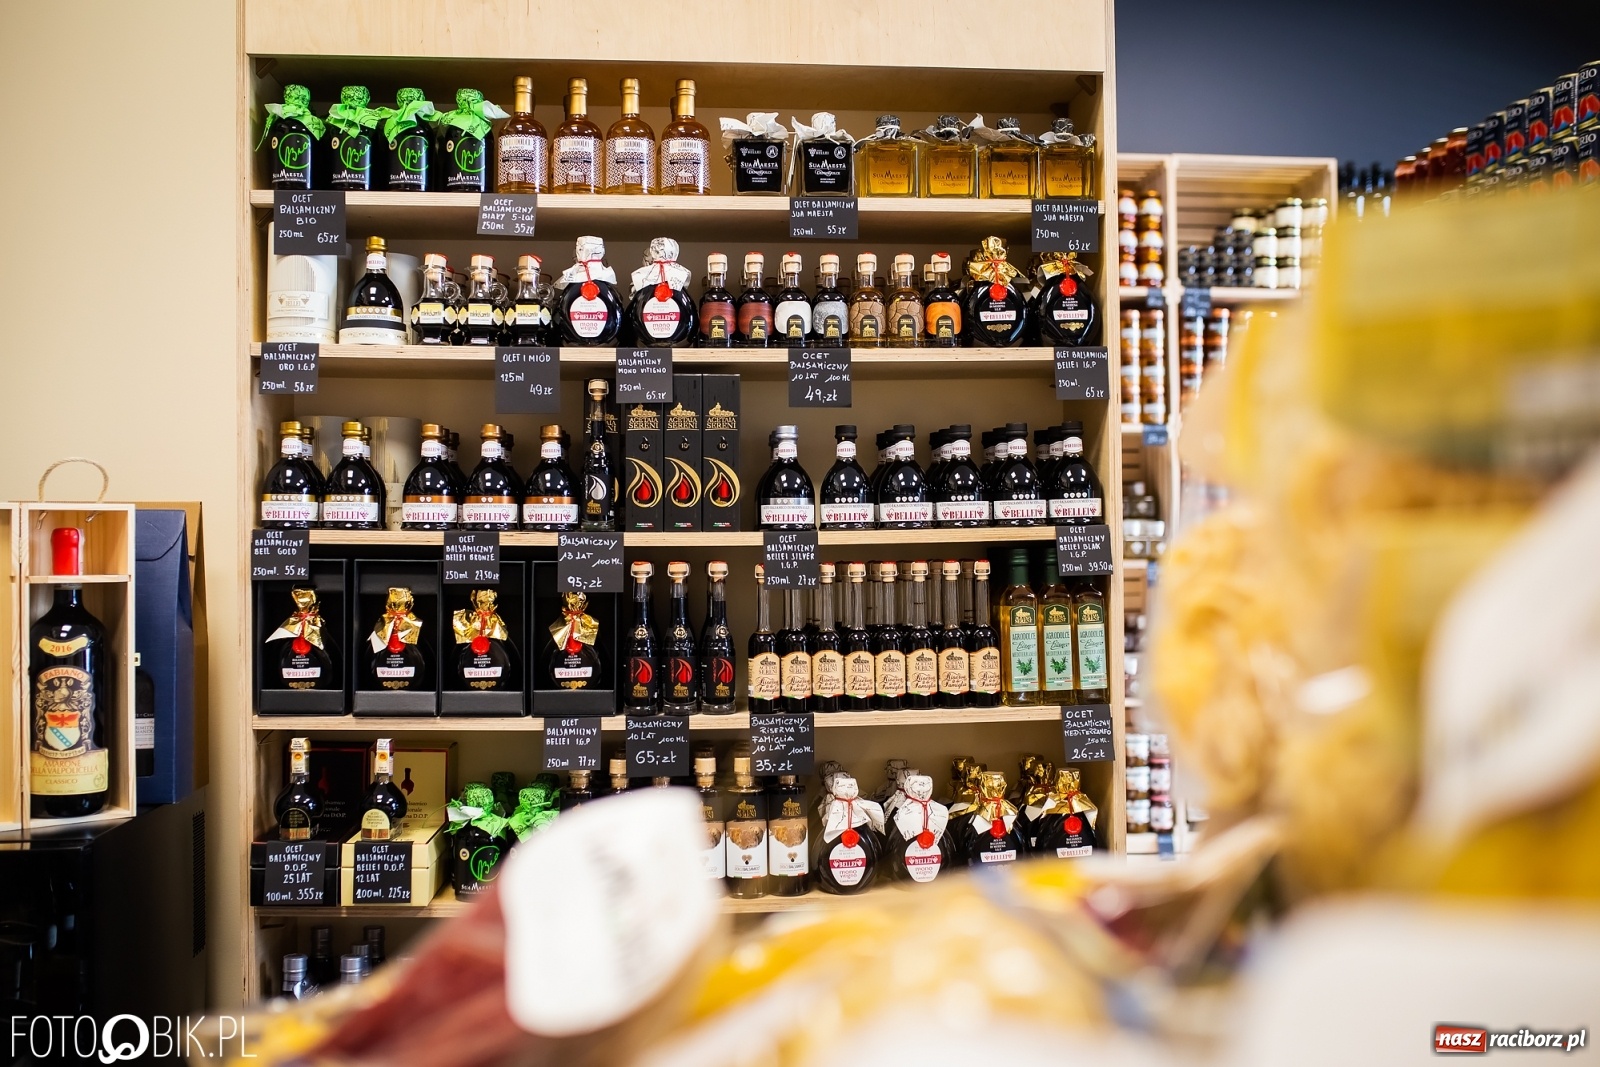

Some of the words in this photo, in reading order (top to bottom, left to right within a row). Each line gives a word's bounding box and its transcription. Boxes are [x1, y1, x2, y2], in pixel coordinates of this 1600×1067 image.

[292, 194, 313, 203] OCET
[280, 205, 336, 214] BALSAMICZNY
[1052, 205, 1097, 214] BALSAMICZNY
[297, 217, 316, 225] BIO
[1060, 214, 1083, 222] MAESTA
[279, 343, 297, 351] OCET
[264, 353, 315, 361] BALSAMICZNY
[503, 354, 520, 362] OCET
[529, 353, 550, 362] MIÓD
[279, 363, 294, 371] ORO
[272, 511, 301, 519] BELLEI
[331, 511, 359, 519] BELLEI
[412, 512, 440, 520] BELLEI
[895, 512, 922, 520] BELLEI
[950, 510, 977, 518] BELLEI
[1011, 509, 1037, 517] BELLEI
[1062, 508, 1090, 516] BELLEI
[474, 513, 501, 521] BELLEI
[535, 513, 562, 521] BELLEI
[772, 513, 800, 521] BELLEI
[834, 513, 861, 521] BELLEI
[459, 535, 475, 543] OCET
[780, 535, 796, 543] OCET
[1059, 535, 1104, 543] BALSAMICZNY
[767, 544, 814, 552] BALSAMICZNY
[559, 552, 573, 561] 13
[1012, 632, 1036, 640] AGRODOLCE
[1046, 631, 1069, 639] AGRODOLCE
[50, 644, 72, 653] 2016
[43, 669, 84, 680] FABIANO
[1066, 710, 1093, 718] OCET
[547, 728, 596, 736] BALSAMICZNY
[641, 732, 656, 740] LAT
[752, 745, 765, 754] 10
[769, 743, 786, 751] LAT
[43, 760, 81, 768] AMARONE
[286, 845, 303, 853] OCET
[372, 845, 388, 853] OCET
[269, 854, 321, 862] BALSAMICZNY
[285, 863, 307, 871] D.O.P.
[384, 863, 404, 871] D.O.P.
[283, 874, 294, 883] 25
[297, 873, 312, 883] LAT
[367, 873, 379, 882] LAT
